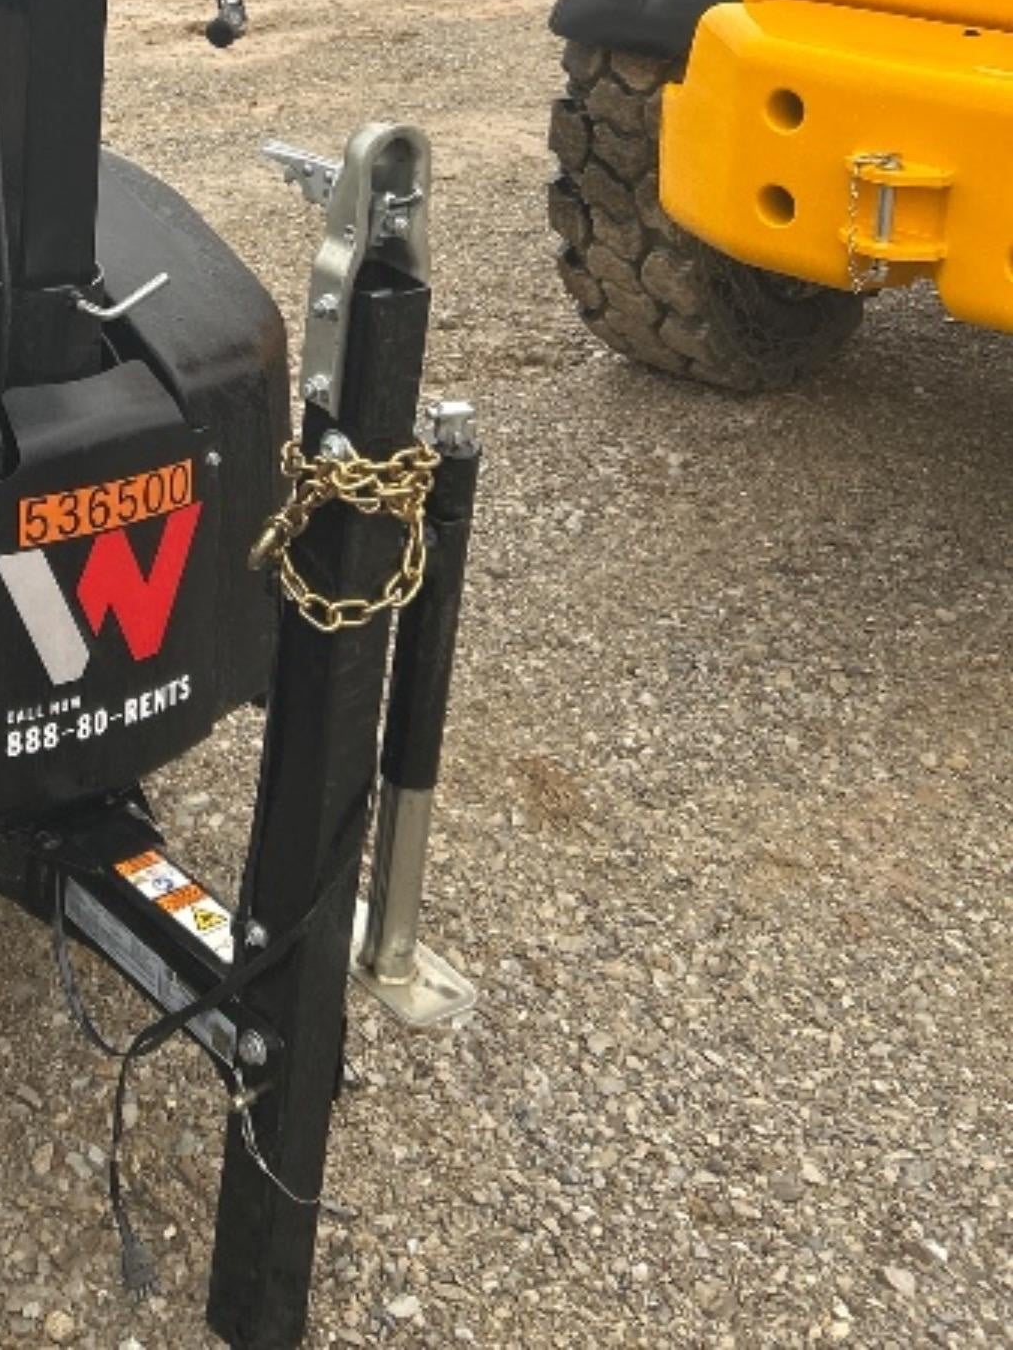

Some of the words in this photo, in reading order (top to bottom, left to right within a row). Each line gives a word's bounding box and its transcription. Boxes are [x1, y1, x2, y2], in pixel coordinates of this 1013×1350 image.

[24, 464, 190, 543] 536500
[6, 673, 192, 758] 888-80-RENTS
[7, 705, 45, 725] CALL
[49, 695, 82, 716] NOW
